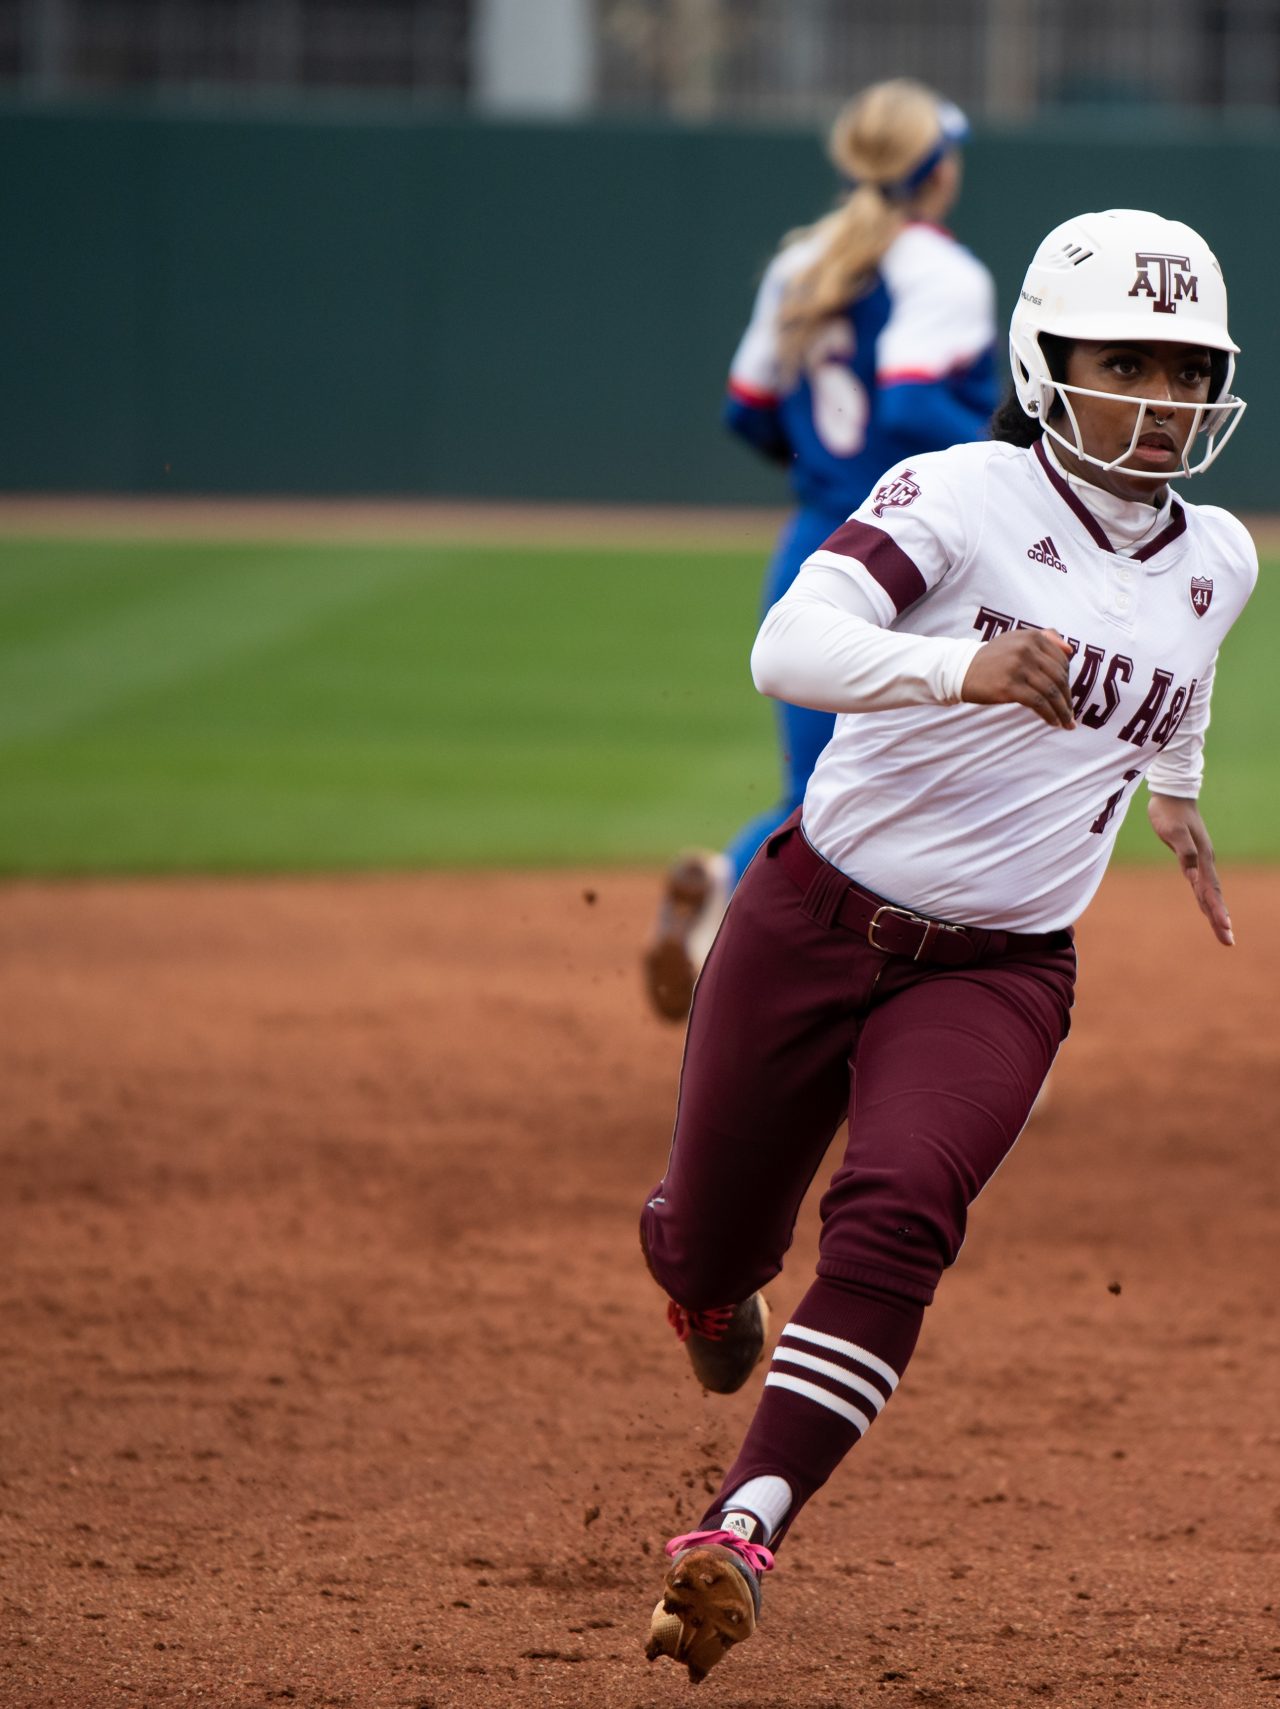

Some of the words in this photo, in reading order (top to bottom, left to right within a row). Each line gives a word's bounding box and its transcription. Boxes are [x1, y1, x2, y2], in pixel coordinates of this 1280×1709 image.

[1027, 548, 1068, 574] adidas
[1193, 589, 1208, 607] 41
[973, 606, 1135, 730] TAS
[1117, 667, 1198, 752] A&
